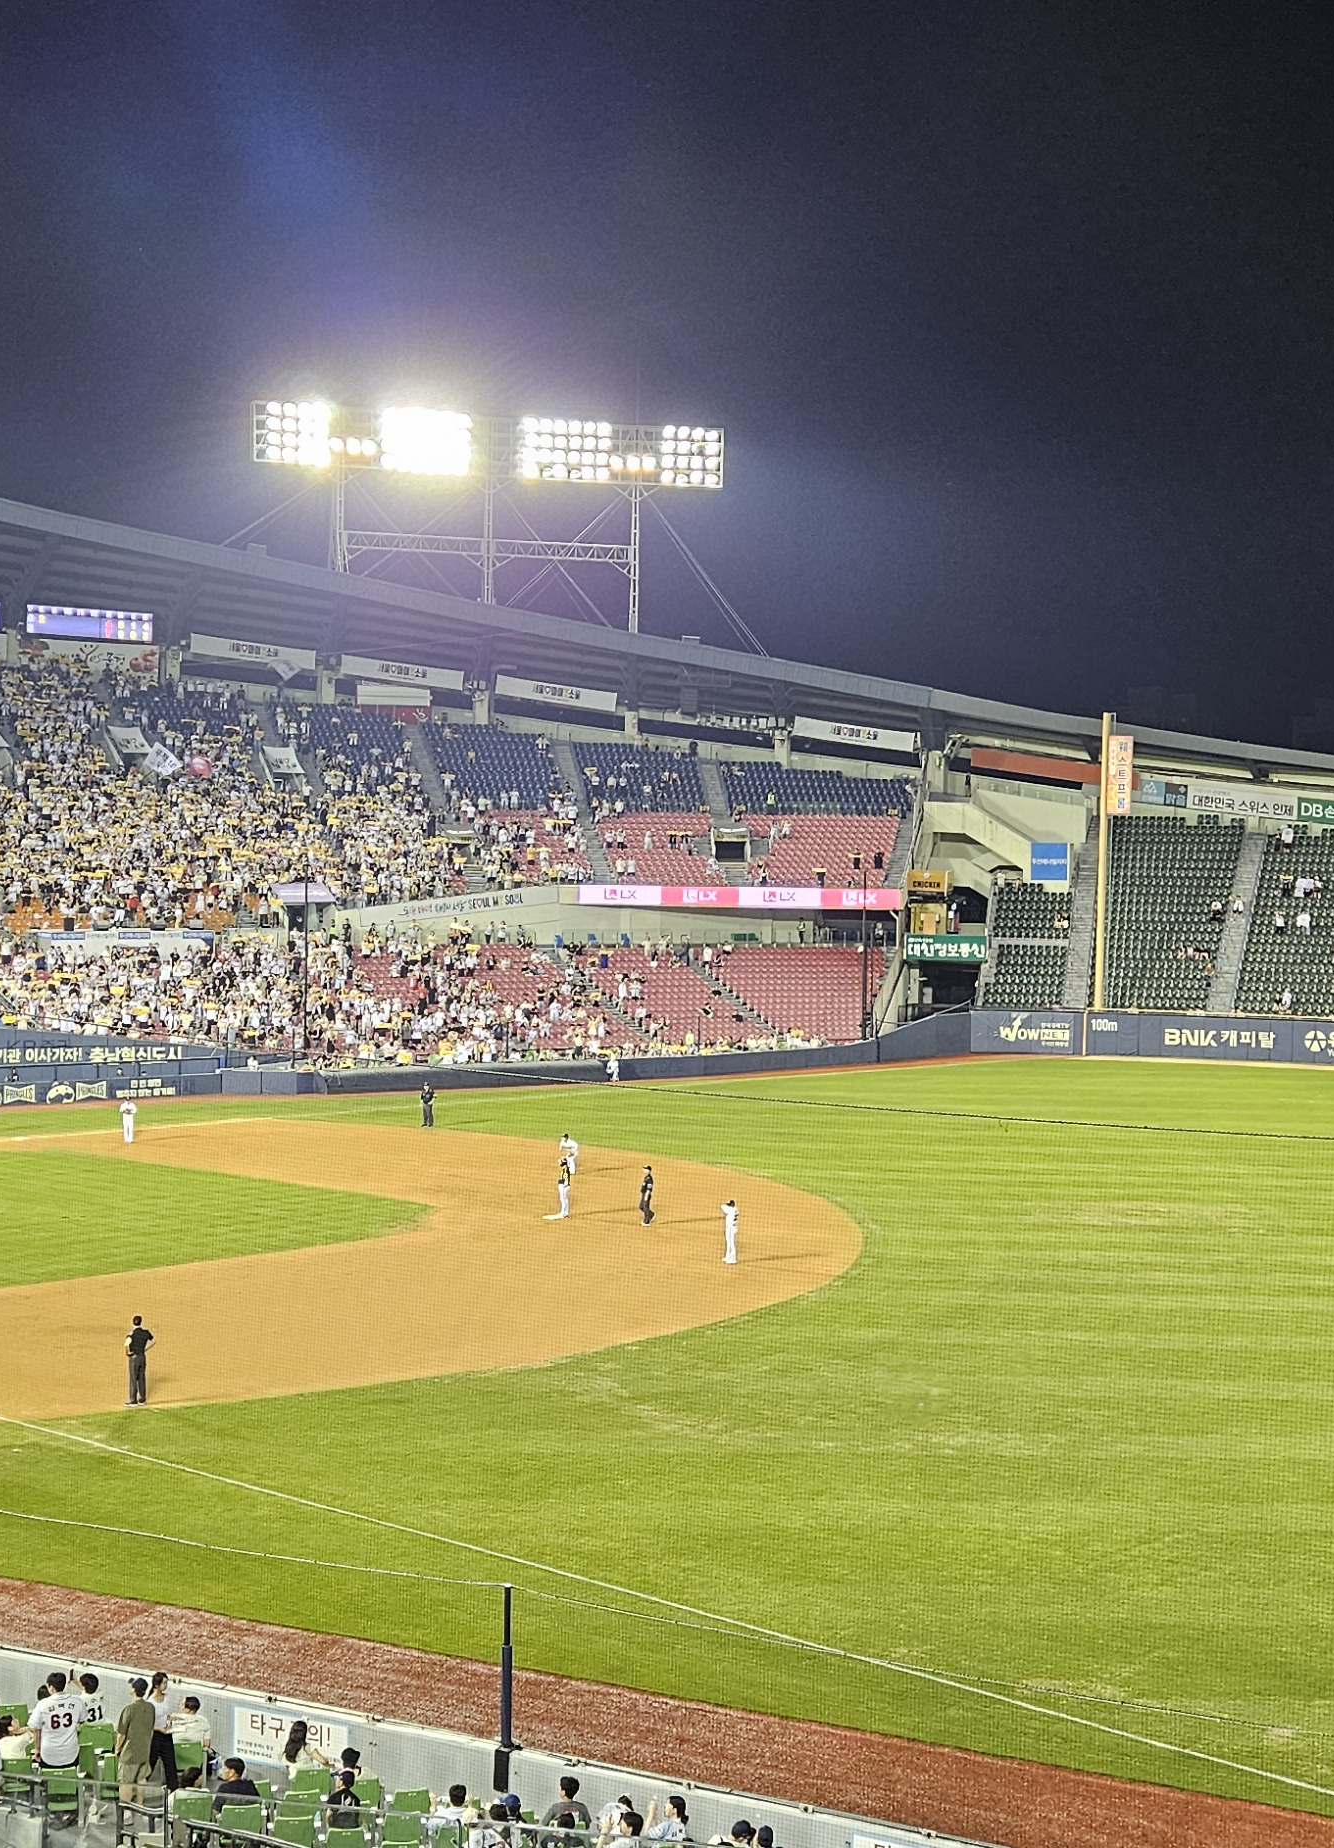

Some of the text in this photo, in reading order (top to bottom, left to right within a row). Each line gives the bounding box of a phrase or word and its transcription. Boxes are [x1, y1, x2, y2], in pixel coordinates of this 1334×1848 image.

[1192, 794, 1235, 812] 대한민국
[1238, 800, 1269, 814] 스위스
[912, 880, 941, 889] CHICKEN
[620, 890, 636, 899] LX
[699, 890, 717, 901] LX
[779, 891, 795, 901] LX
[907, 943, 985, 958] 대신정보통신
[1090, 1018, 1118, 1032] 100m
[25, 1047, 83, 1063] 이사가자!
[5, 1086, 33, 1102] PRINGLES
[51, 1712, 73, 1730] 63
[87, 1704, 103, 1723] 31
[250, 1713, 285, 1739] 타구
